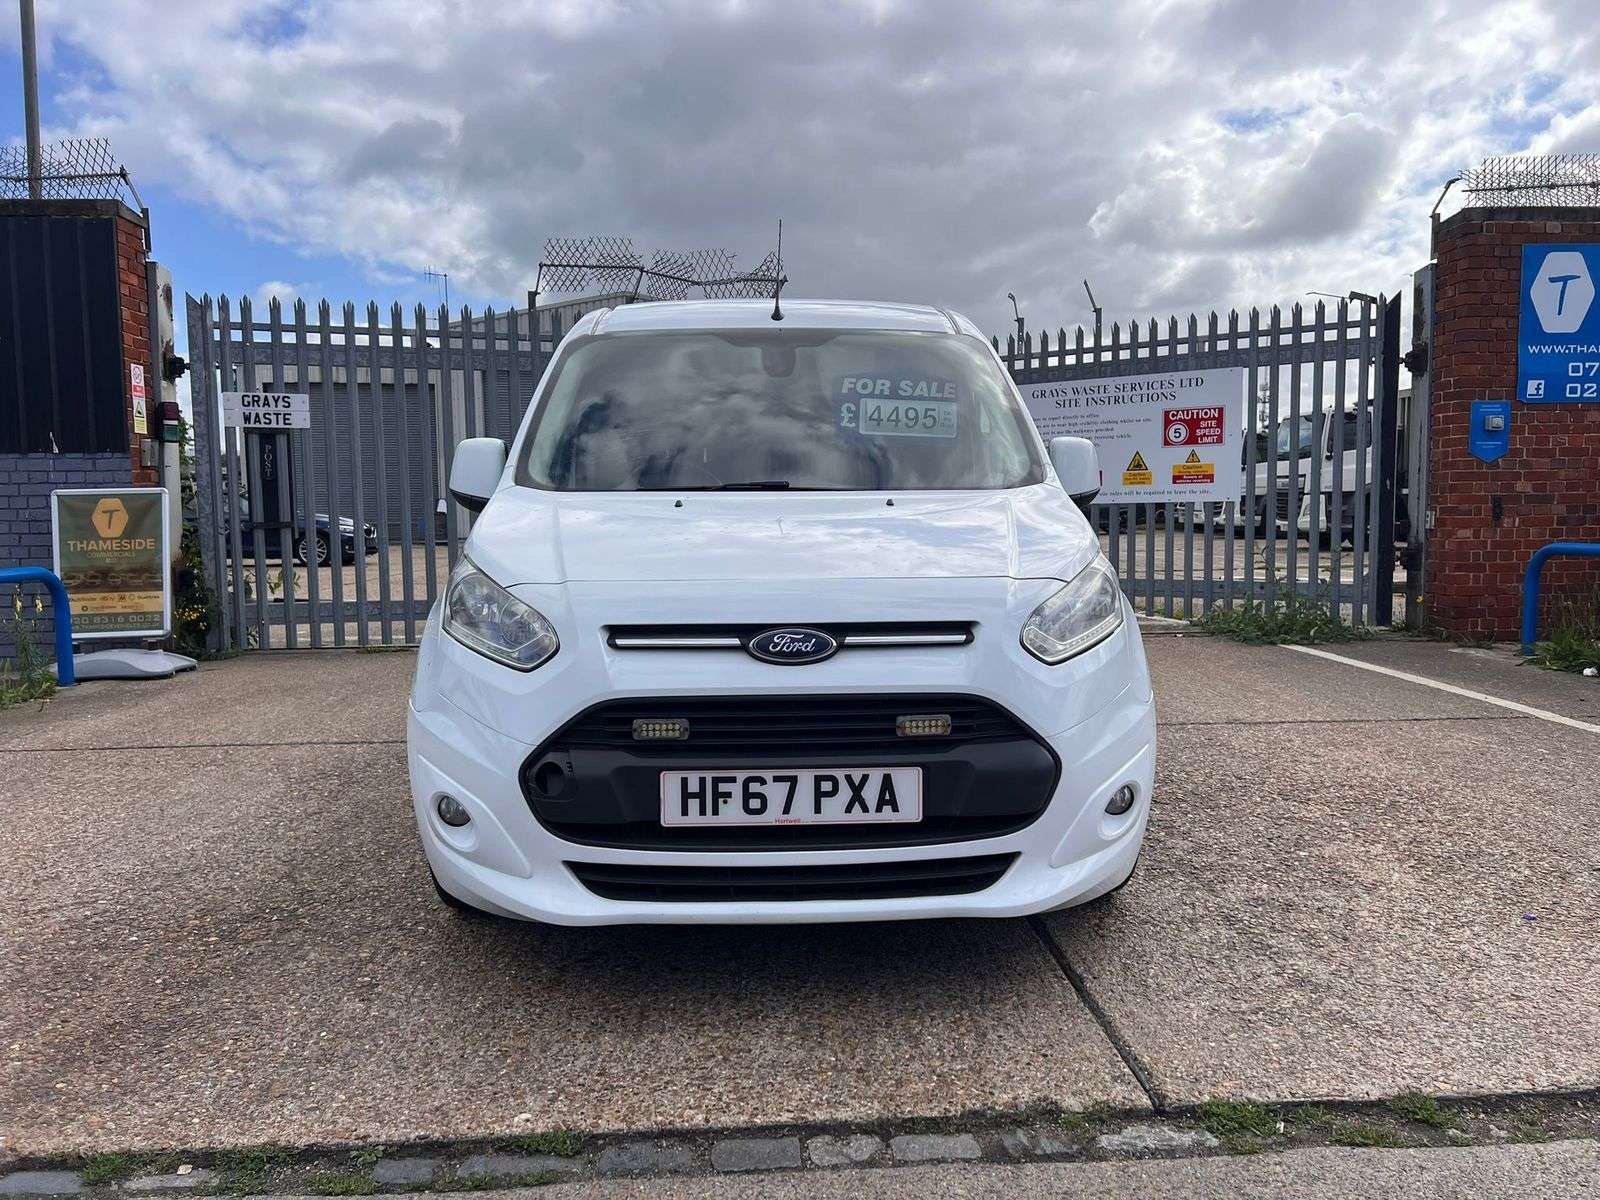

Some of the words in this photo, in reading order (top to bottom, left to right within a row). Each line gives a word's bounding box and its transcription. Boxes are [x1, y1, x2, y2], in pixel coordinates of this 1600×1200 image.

[1527, 344, 1600, 354] WWW.THA
[841, 377, 891, 395] FOR
[898, 379, 957, 398] SALE
[1031, 387, 1067, 399] GRAYS
[1071, 384, 1110, 397] WASTE
[1114, 380, 1175, 394] SERVICES
[1180, 377, 1204, 389] LTD
[241, 394, 291, 408] GRAYS
[1055, 397, 1081, 409] SITE
[1085, 390, 1176, 407] INSTRUCTIONS
[242, 411, 292, 426] WASTE
[840, 401, 856, 428] £
[868, 404, 938, 429] 4495
[1169, 408, 1219, 421] CAUTION
[1200, 420, 1217, 428] SITE
[1173, 427, 1181, 439] 5
[1195, 428, 1221, 436] SPEED
[1198, 435, 1217, 443] LIMIT
[264, 444, 273, 477] POST
[67, 538, 155, 552] THAMESIDE
[769, 633, 816, 653] Ford
[680, 775, 798, 816] HF67
[813, 773, 900, 815] PXA
